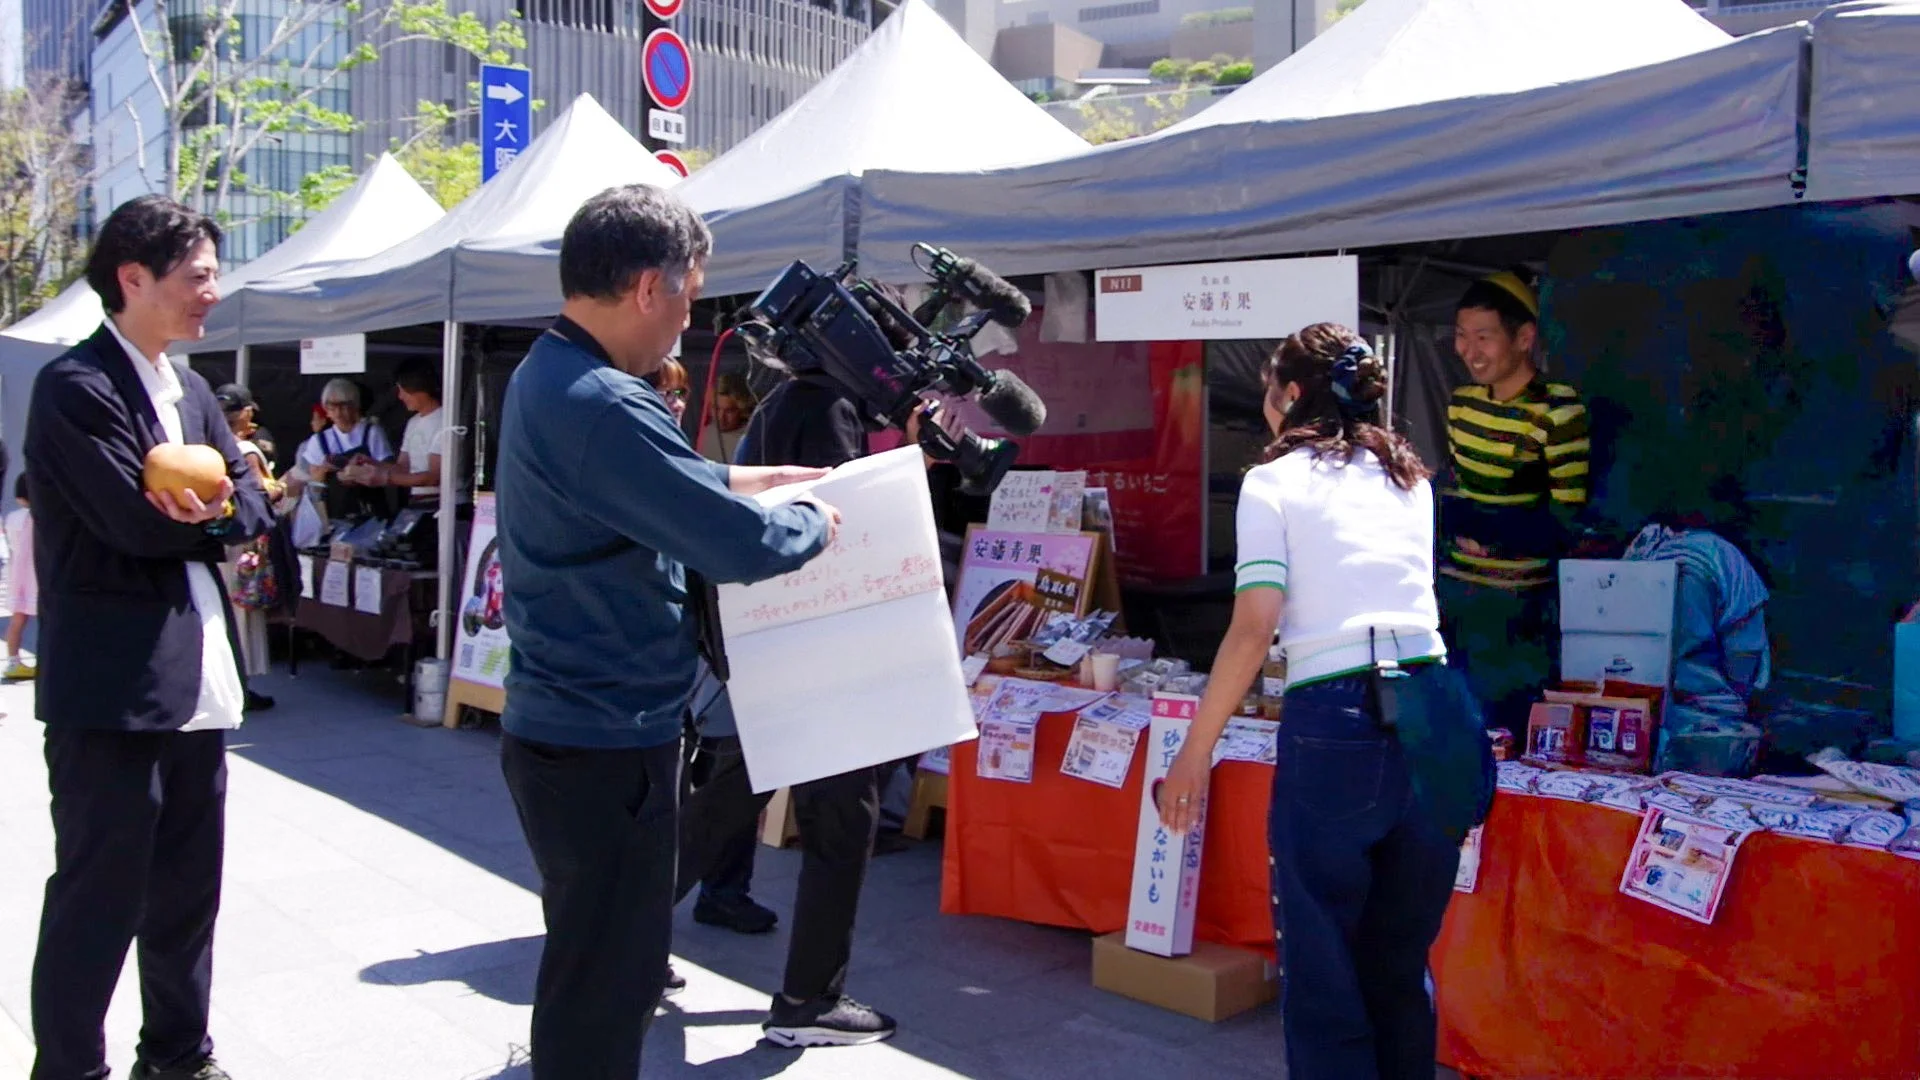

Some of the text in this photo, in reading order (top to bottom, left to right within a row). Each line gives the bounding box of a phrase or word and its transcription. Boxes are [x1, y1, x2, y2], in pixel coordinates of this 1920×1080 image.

[652, 117, 684, 135] 自動車
[1183, 291, 1251, 311] 安藤青果
[974, 538, 1042, 564] 安藤青果
[1038, 574, 1077, 597] 鳥取県
[1156, 701, 1191, 717] 特産
[1148, 826, 1169, 904] ながいも
